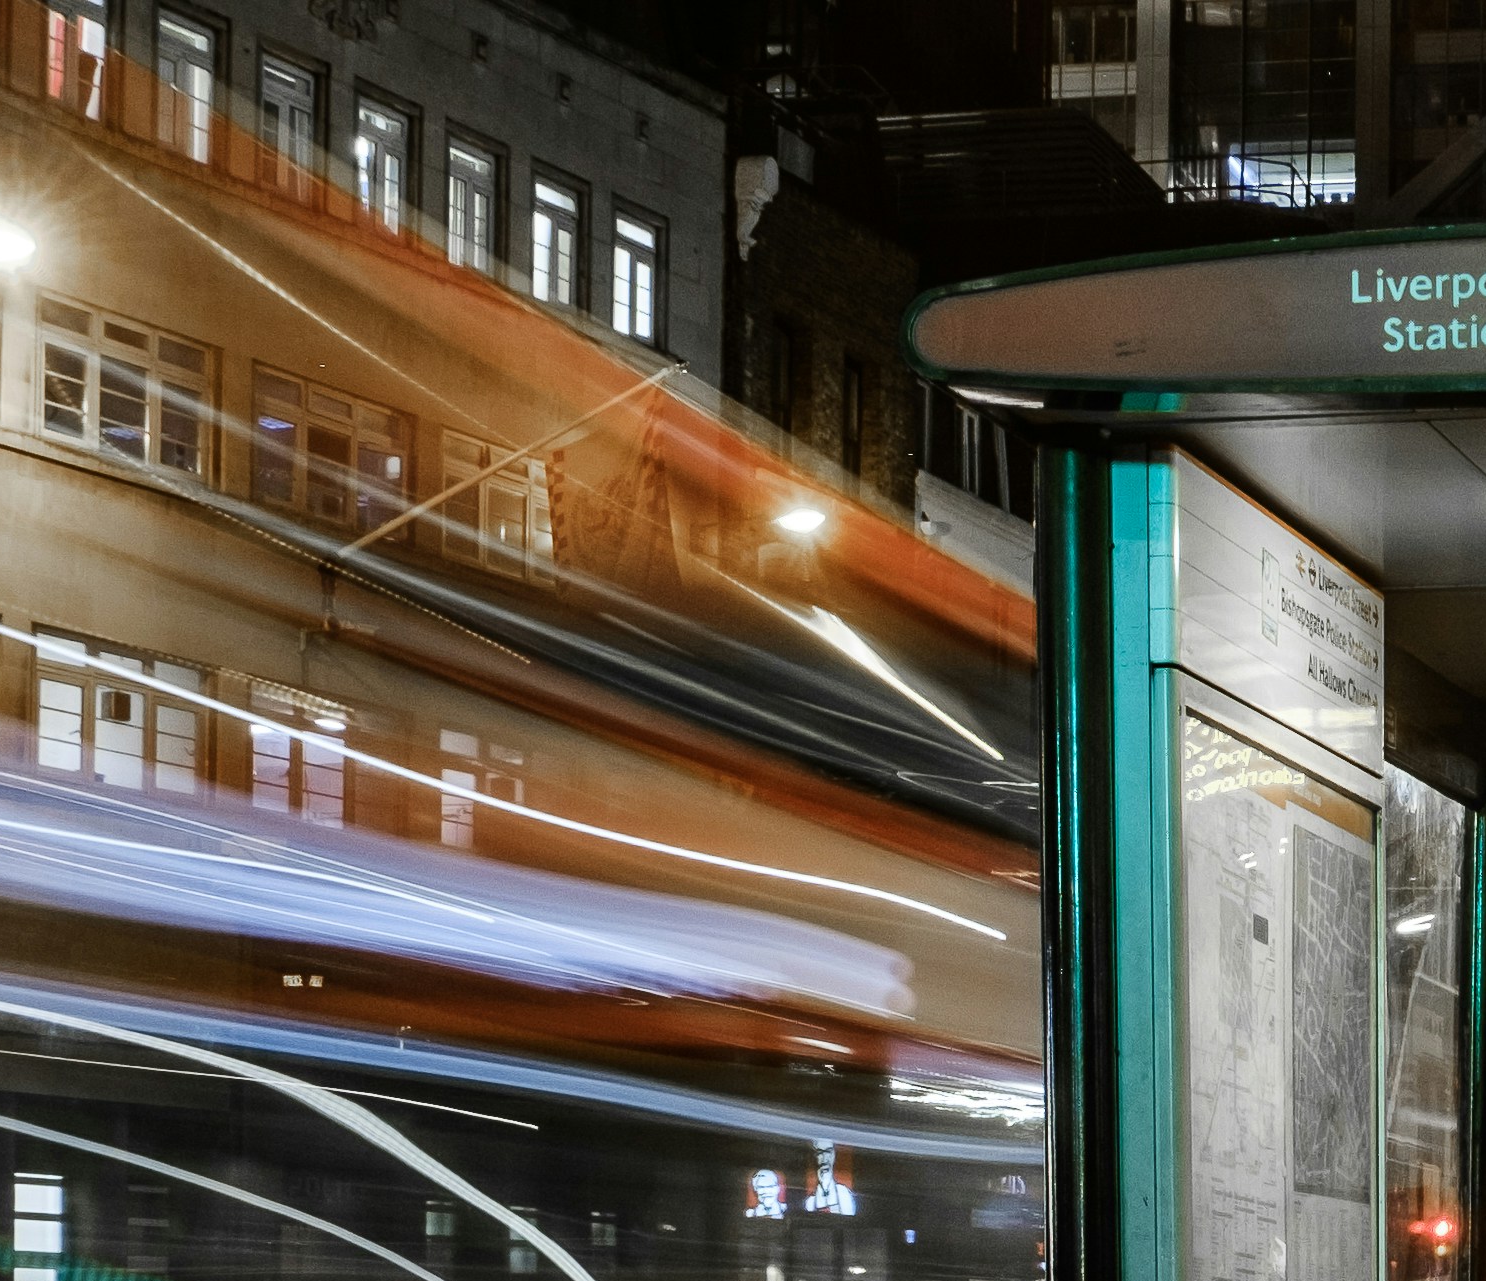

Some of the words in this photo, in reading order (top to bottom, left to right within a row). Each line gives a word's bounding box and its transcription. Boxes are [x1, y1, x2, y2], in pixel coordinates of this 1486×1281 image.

[1318, 566, 1352, 612] Liverpool
[1351, 588, 1372, 625] Street
[1281, 588, 1325, 638] Bishopsgate
[1326, 617, 1347, 653] Police
[1349, 632, 1374, 672] Station
[1308, 652, 1318, 682] All
[1319, 660, 1347, 699] Hallows
[1348, 677, 1374, 709] Church
